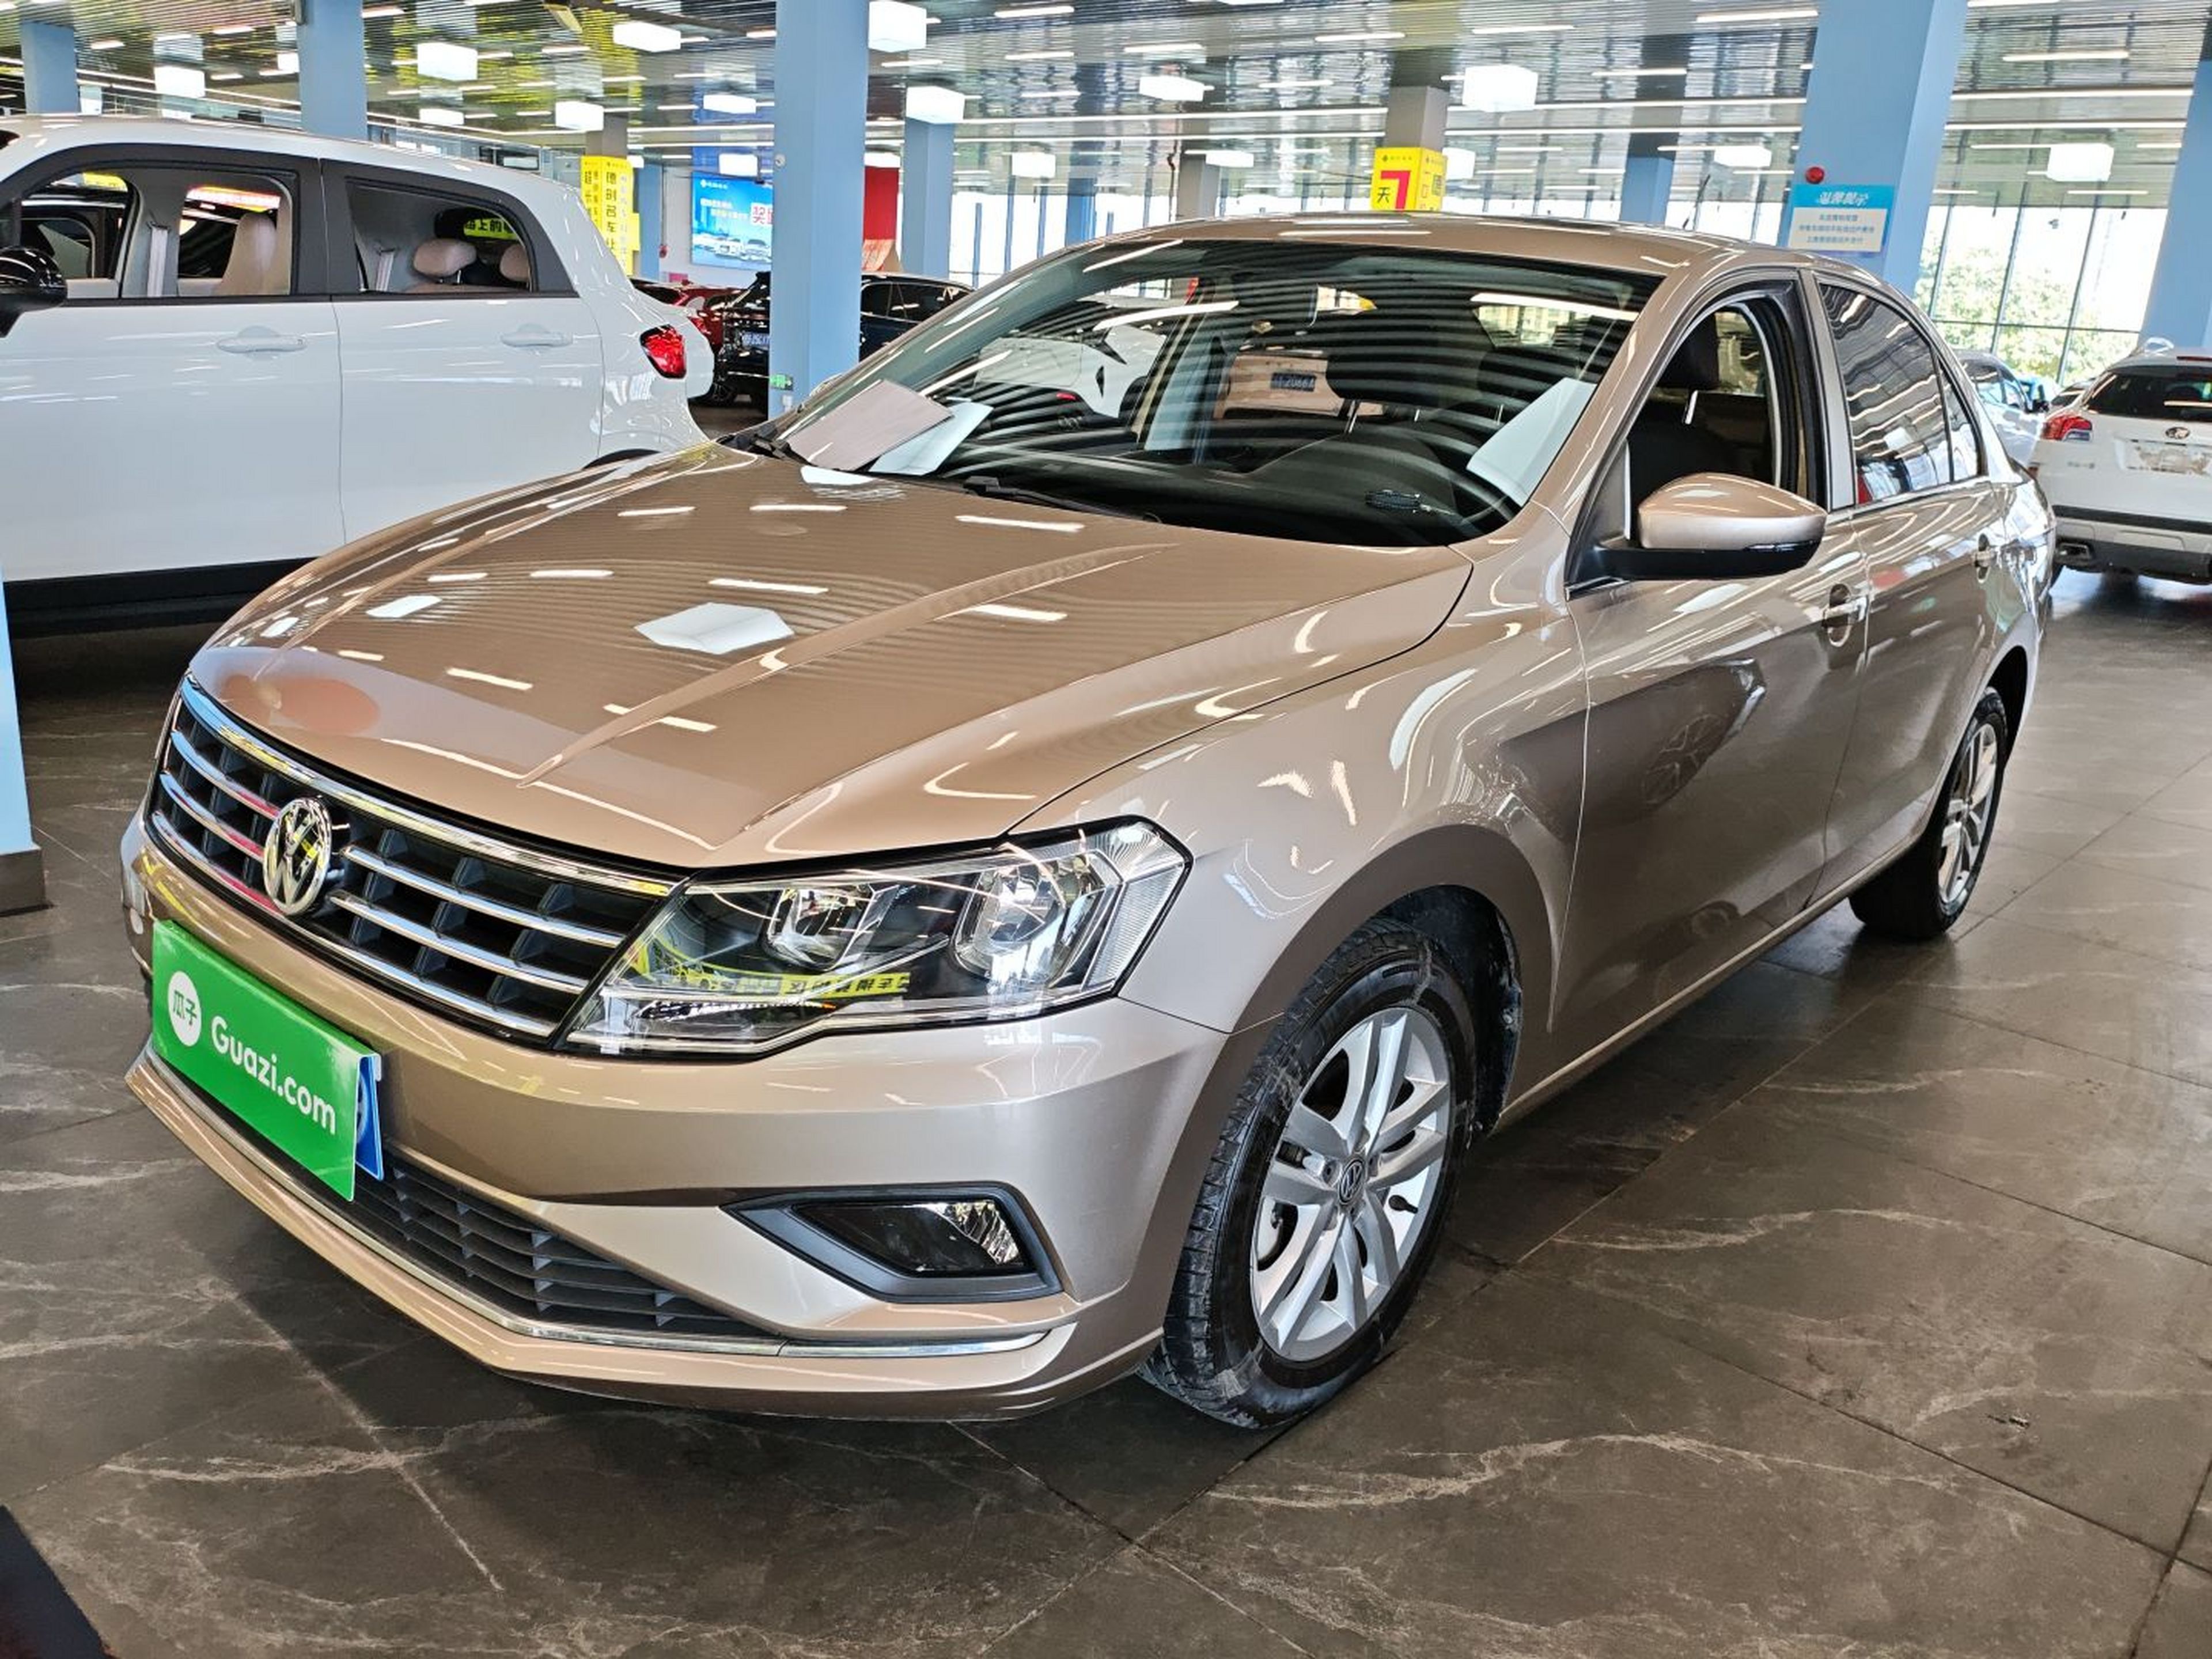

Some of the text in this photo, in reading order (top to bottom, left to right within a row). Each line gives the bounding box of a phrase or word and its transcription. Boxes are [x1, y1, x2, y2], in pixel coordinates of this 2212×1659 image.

[1377, 187, 1390, 203] 天
[1381, 170, 1411, 209] 7
[173, 990, 197, 1026] 瓜子
[210, 1015, 336, 1136] Guazi.com
